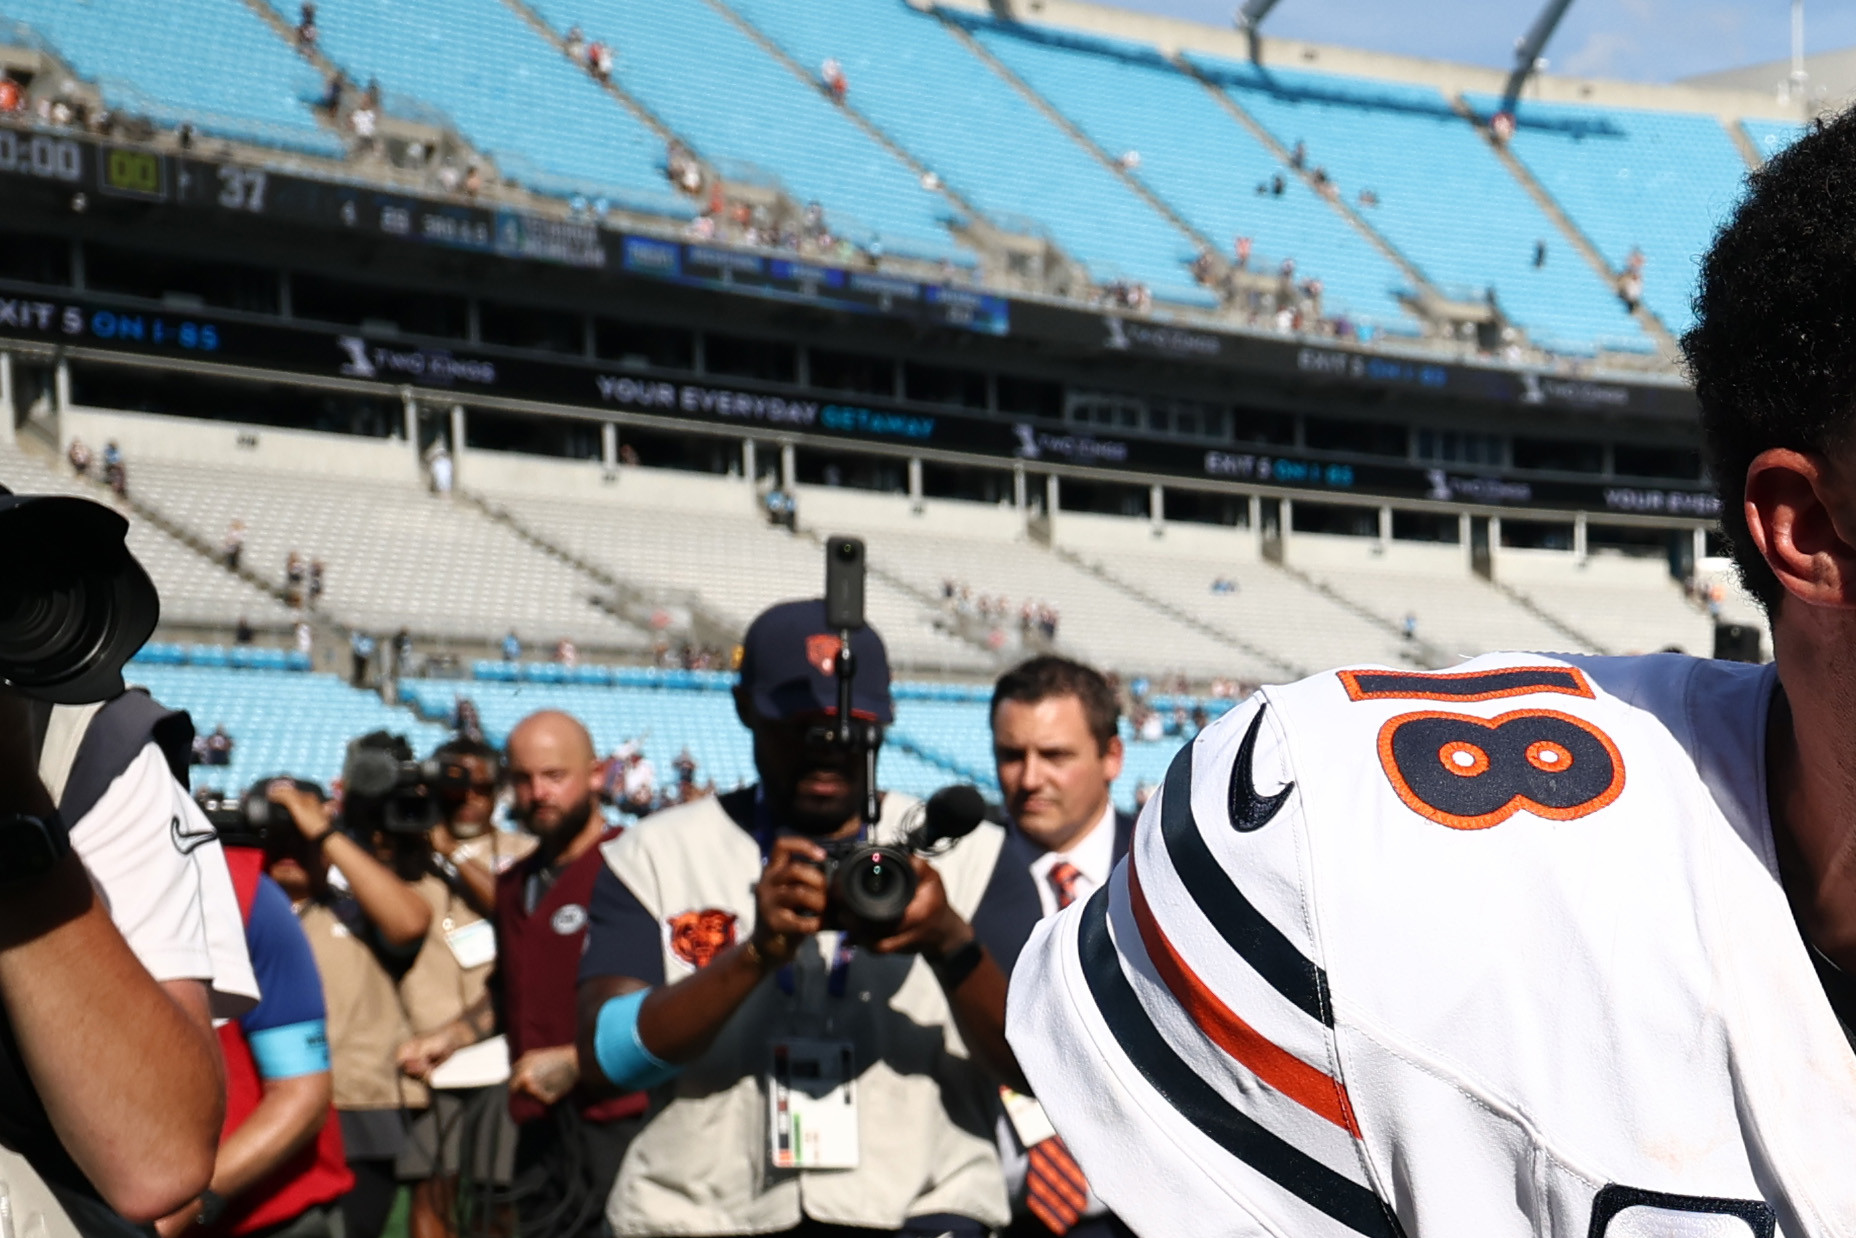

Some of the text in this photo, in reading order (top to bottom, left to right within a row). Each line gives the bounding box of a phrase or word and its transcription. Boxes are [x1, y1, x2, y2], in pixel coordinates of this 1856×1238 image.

[217, 165, 267, 213] 37
[62, 304, 84, 335] 5
[91, 310, 145, 341] ON
[596, 373, 677, 409] YOUR
[678, 383, 819, 427] EVERYDAY
[1336, 665, 1626, 830] 18
